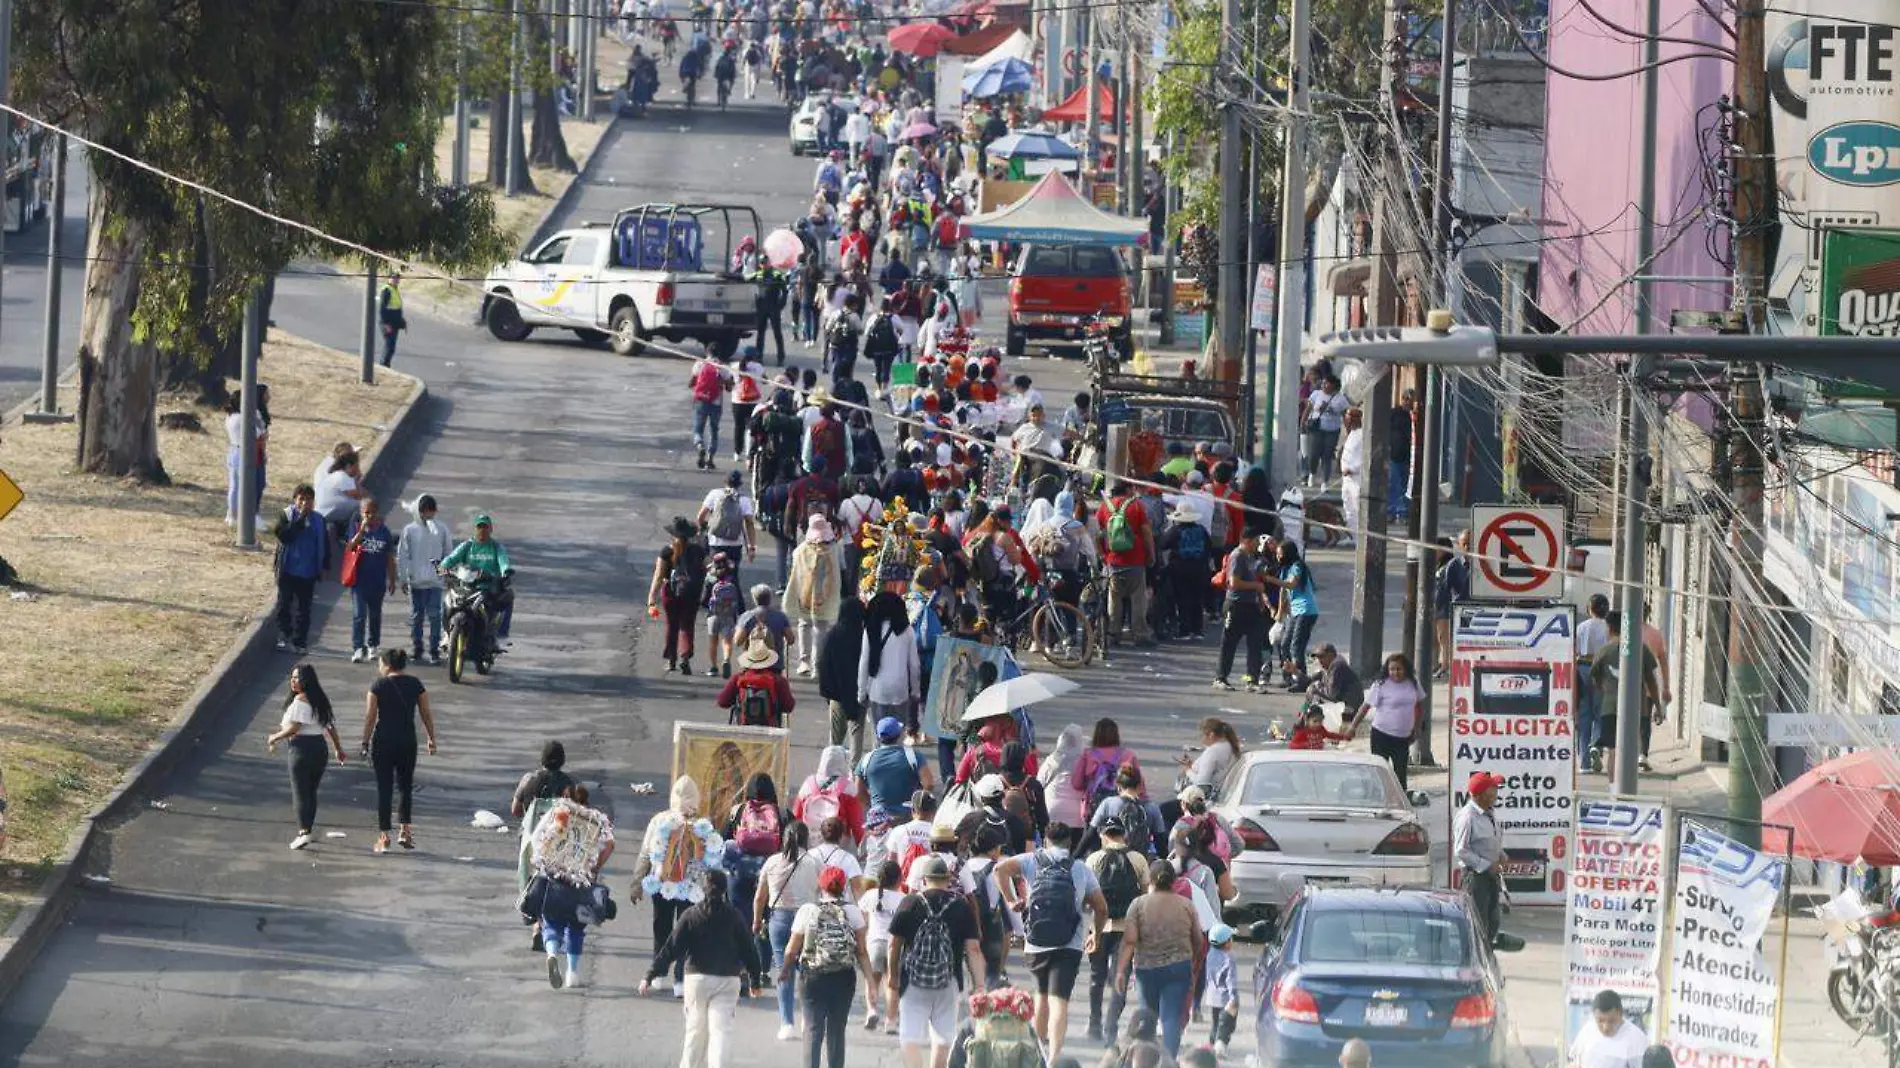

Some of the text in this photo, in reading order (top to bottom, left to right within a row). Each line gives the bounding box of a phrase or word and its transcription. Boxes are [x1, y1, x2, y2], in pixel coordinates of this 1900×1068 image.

[1810, 25, 1893, 81] FTE
[1809, 85, 1894, 96] automotive
[1456, 612, 1570, 647] EDA
[1455, 718, 1571, 736] SOLICITA
[1456, 743, 1571, 764] Ayudante
[1454, 791, 1571, 809] Mcánico
[1578, 804, 1662, 835] EDA
[1575, 857, 1660, 876] BATERIAS
[1681, 827, 1782, 891] EDA
[1574, 874, 1659, 894] OFERTA
[1574, 894, 1657, 913] Mobil 4T
[1574, 915, 1656, 933] Para Moto
[1571, 934, 1607, 947] Precio
[1609, 938, 1629, 949] por
[1569, 962, 1607, 974] Precio
